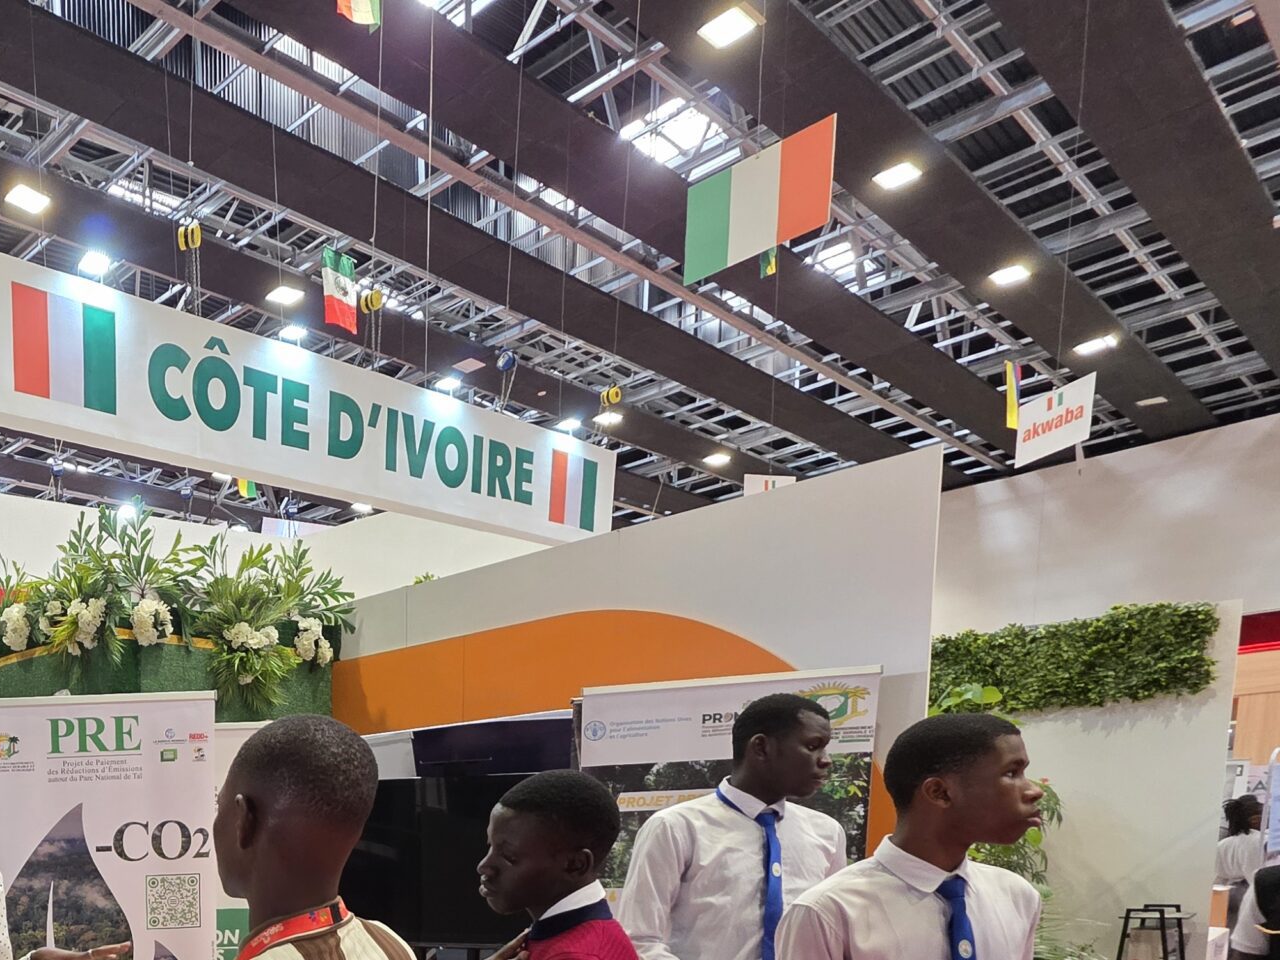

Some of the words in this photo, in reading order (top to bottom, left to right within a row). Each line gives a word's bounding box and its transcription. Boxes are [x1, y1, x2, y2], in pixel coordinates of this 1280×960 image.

[147, 335, 310, 451] CÔTE
[327, 389, 534, 506] D'IVOIRE
[1022, 404, 1084, 443] akwaba
[46, 715, 142, 754] PRE
[62, 760, 84, 768] Projet
[95, 758, 127, 766] Paiement
[60, 766, 99, 775] Réductions
[80, 774, 93, 782] Parc
[95, 773, 122, 781] National
[618, 795, 671, 808] PROJET
